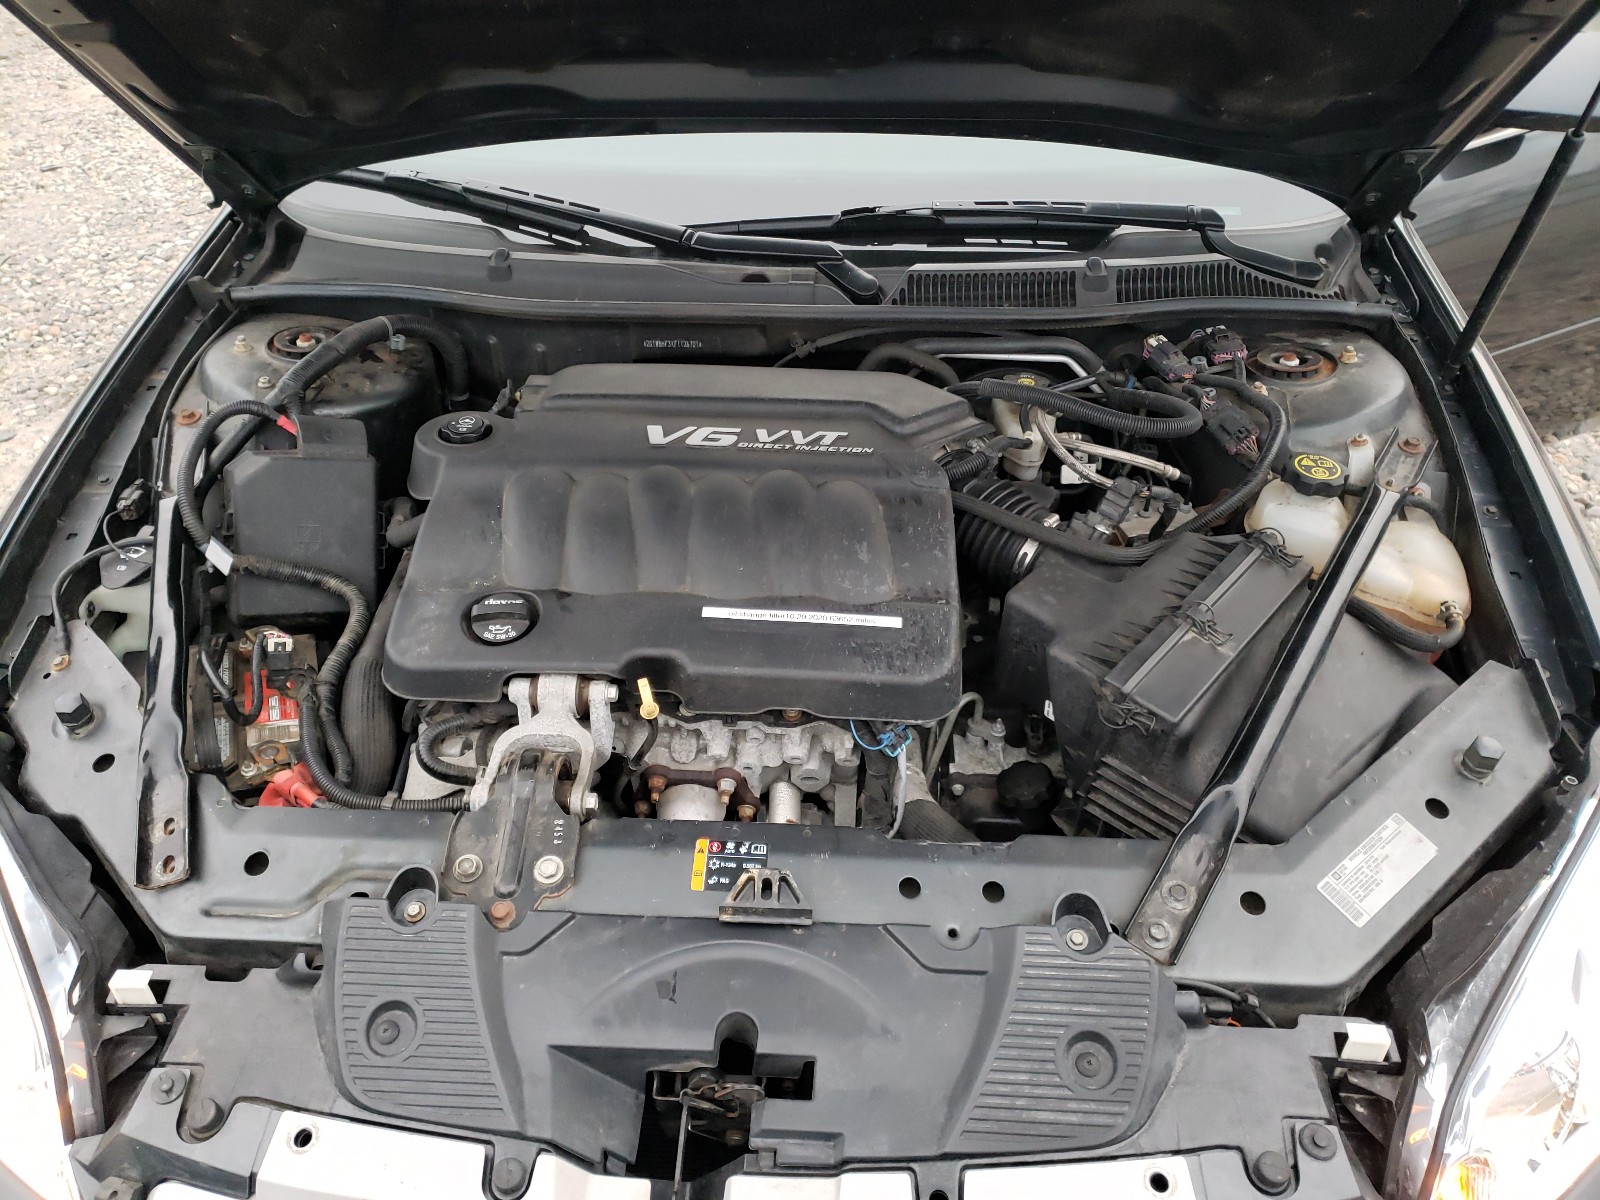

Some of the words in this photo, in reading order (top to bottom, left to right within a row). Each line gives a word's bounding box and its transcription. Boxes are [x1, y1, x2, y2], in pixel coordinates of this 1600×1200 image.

[646, 424, 742, 447] V6
[755, 428, 849, 446] VVT
[737, 441, 794, 450] DIRECT
[795, 444, 875, 453] INJECTION
[495, 631, 517, 640] 5W-30
